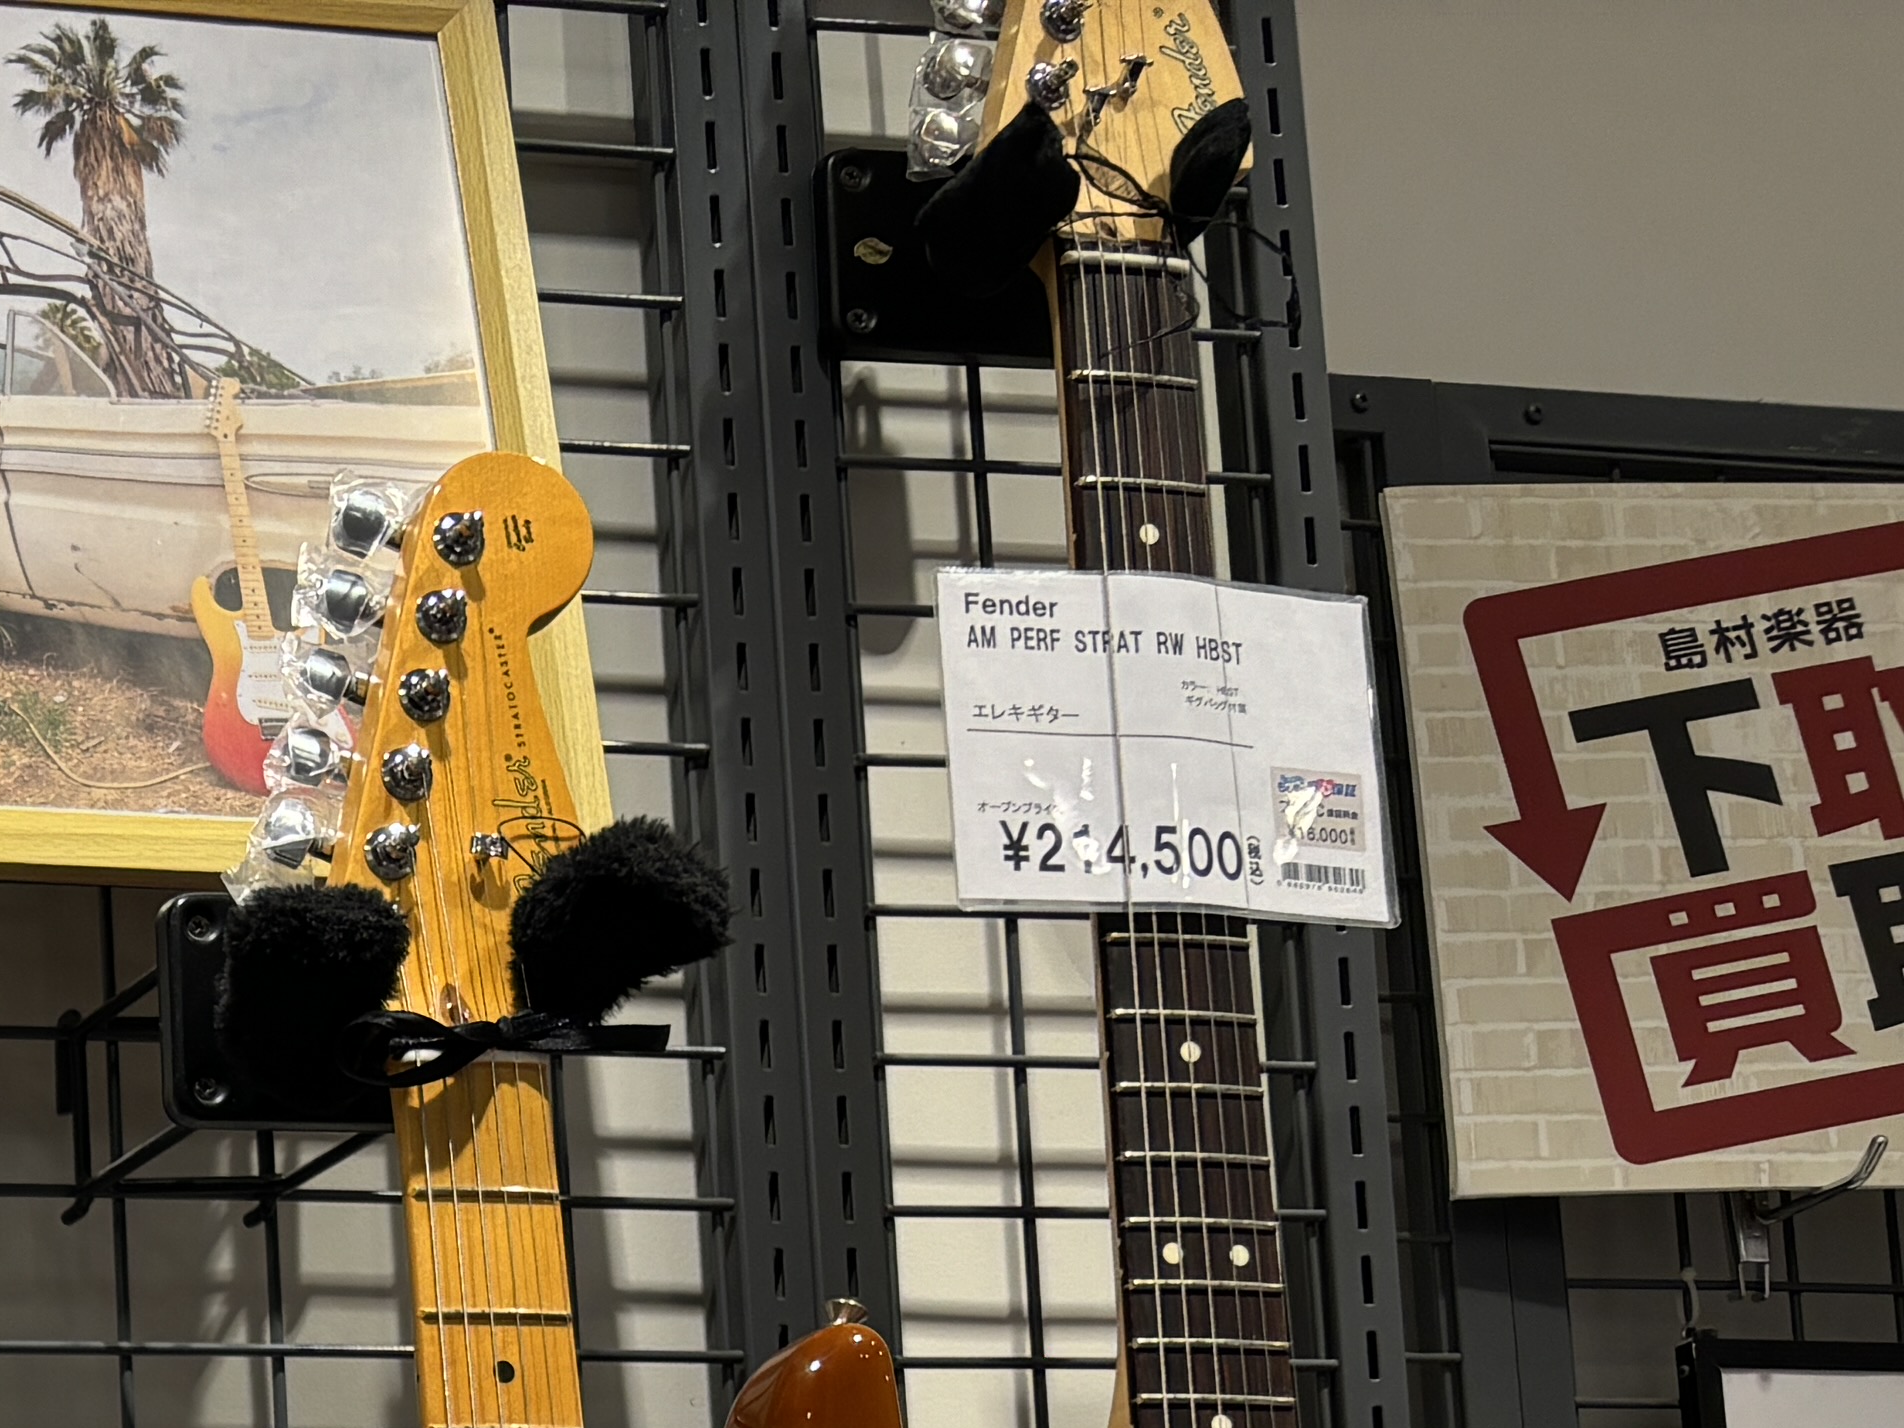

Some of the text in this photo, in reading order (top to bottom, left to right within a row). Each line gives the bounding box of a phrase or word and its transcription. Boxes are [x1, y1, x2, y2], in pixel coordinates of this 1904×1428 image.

[964, 593, 1058, 619] Fender
[967, 625, 1242, 665] AM PERF STRAT RW HBST
[1658, 597, 1865, 673] 島村楽器
[973, 704, 1079, 723] エレキギター
